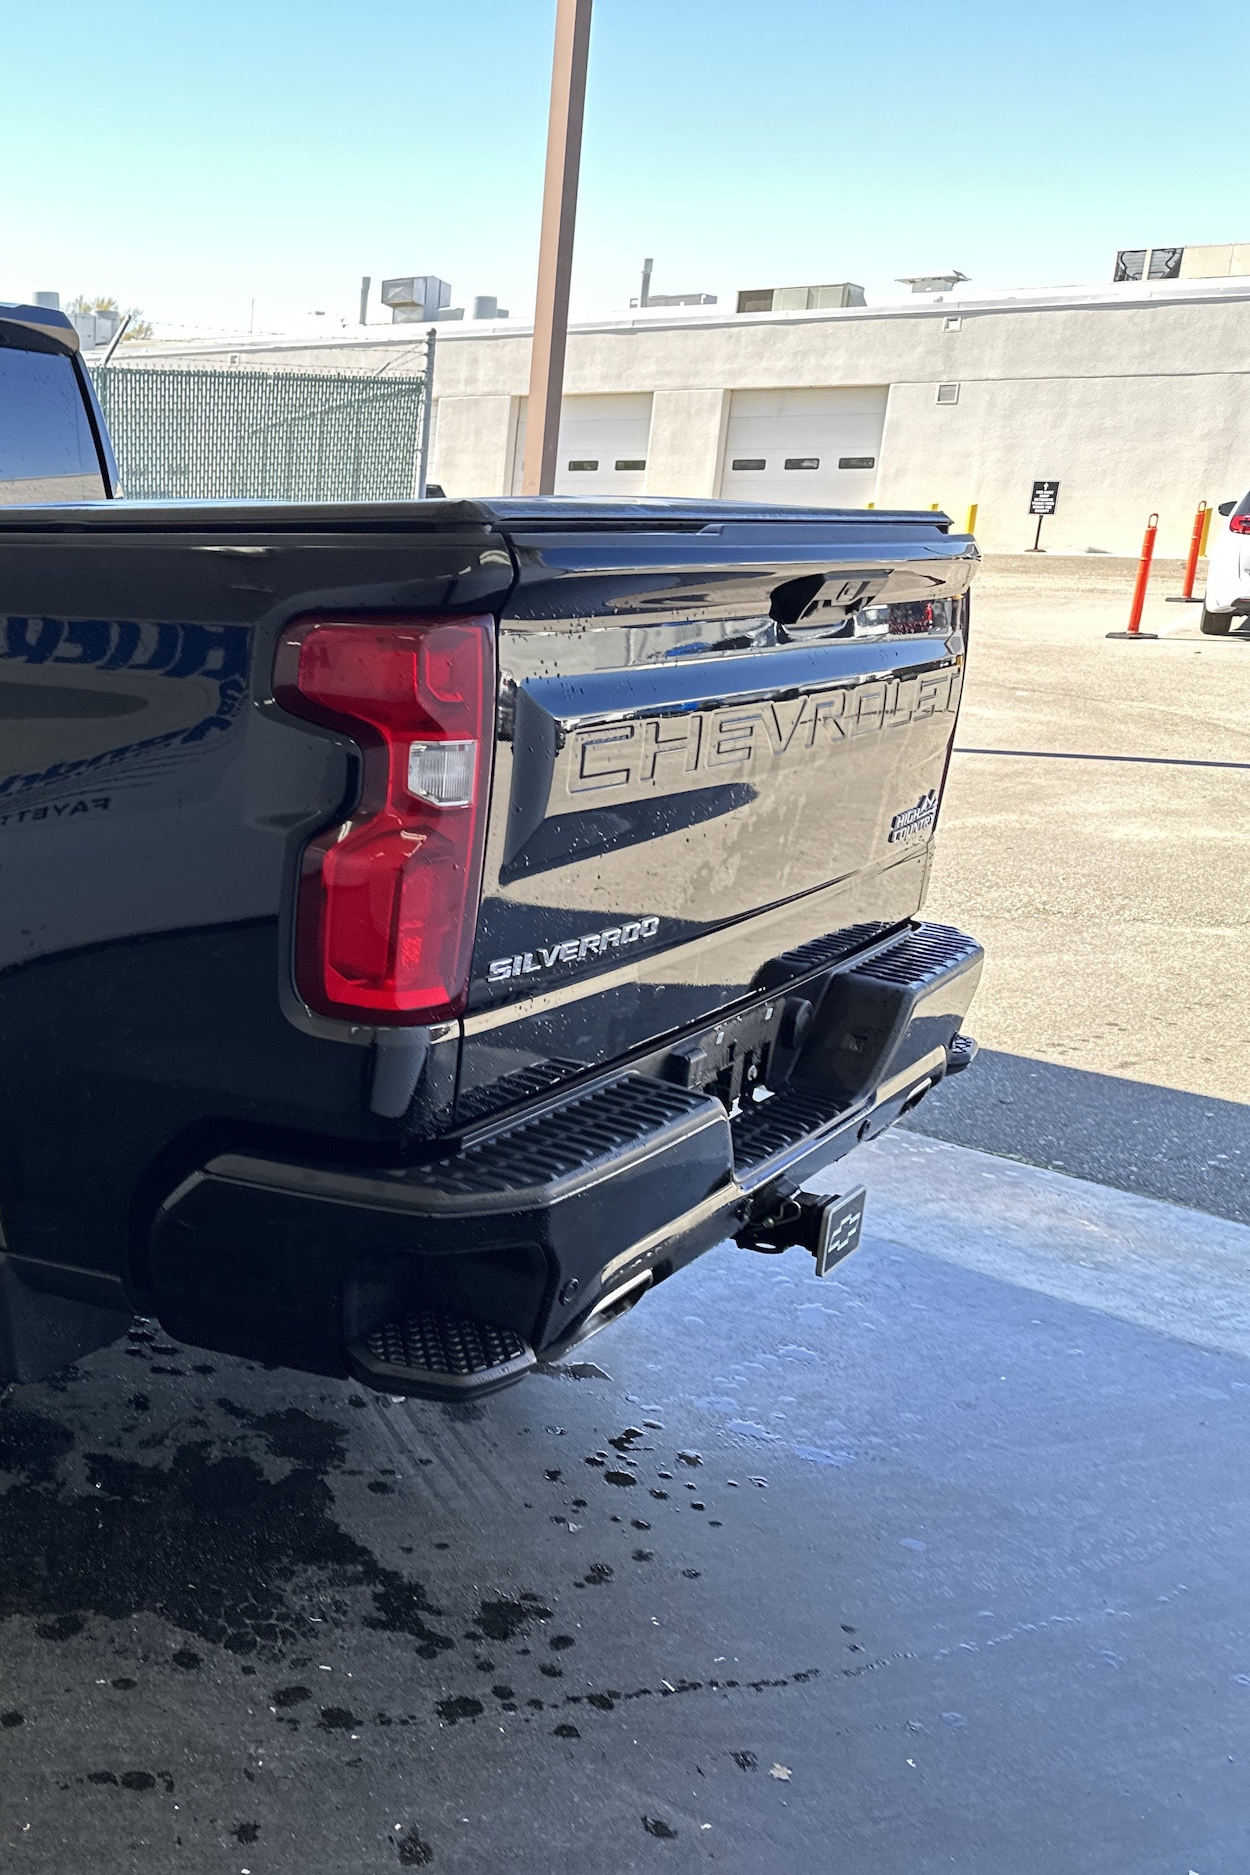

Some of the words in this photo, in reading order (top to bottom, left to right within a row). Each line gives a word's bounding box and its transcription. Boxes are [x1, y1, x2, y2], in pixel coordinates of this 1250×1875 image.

[566, 666, 961, 794] CHEVROLET
[893, 808, 921, 829] HIGH
[485, 915, 661, 983] SILVERADO
